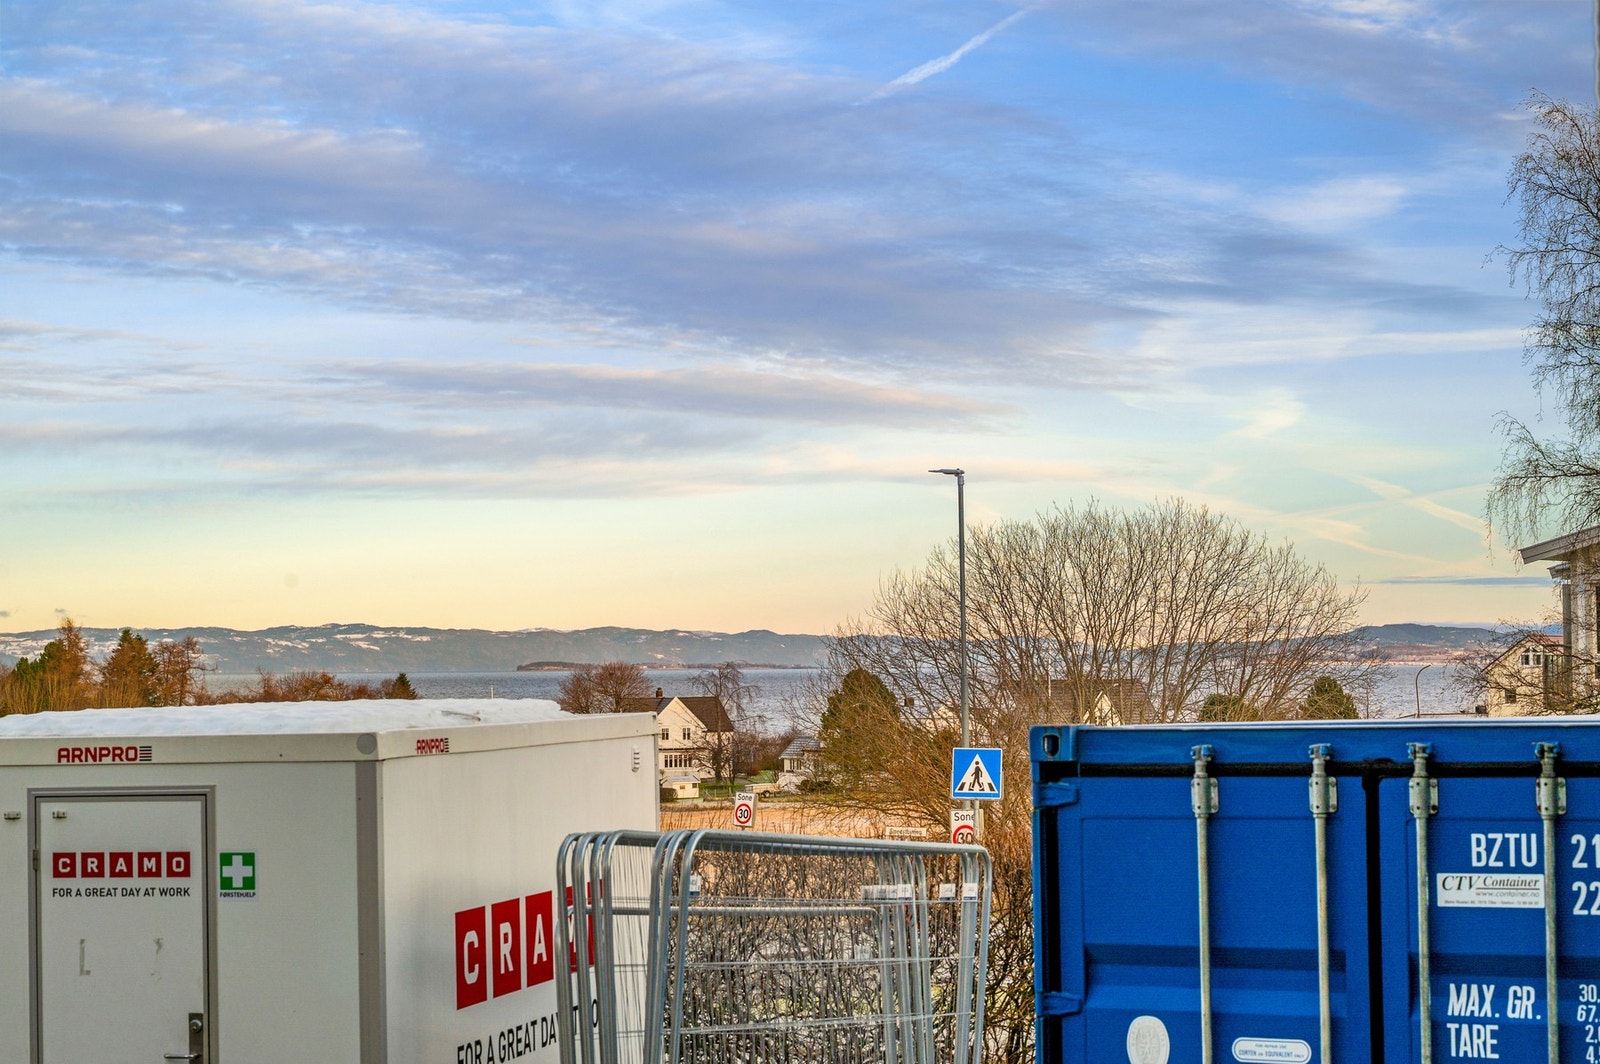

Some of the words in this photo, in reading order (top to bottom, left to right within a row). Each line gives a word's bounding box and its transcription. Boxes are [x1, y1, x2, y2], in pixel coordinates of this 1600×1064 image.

[57, 746, 138, 763] ARNPRO
[416, 738, 445, 755] ARNPRO
[738, 793, 753, 801] Sone
[738, 808, 749, 819] 30
[1470, 833, 1538, 868] BZTU
[1571, 833, 1600, 868] 21
[55, 854, 188, 876] CRAMO
[52, 887, 73, 897] FOR
[75, 887, 82, 897] A
[85, 887, 118, 897] GREAT
[121, 887, 142, 897] DAY
[143, 887, 157, 897] AT
[158, 887, 191, 897] WORK
[1442, 875, 1480, 891] CTV
[1483, 876, 1540, 888] Container
[1475, 891, 1540, 899] www.container.no
[1572, 881, 1600, 915] 22
[1447, 983, 1500, 1018] MAX.
[1507, 985, 1541, 1020] GR.
[1577, 1005, 1600, 1023] 67.
[487, 1035, 495, 1064] A
[498, 1019, 538, 1063] GREAT
[1446, 1023, 1499, 1059] TARE
[1586, 1046, 1600, 1064] 4.
